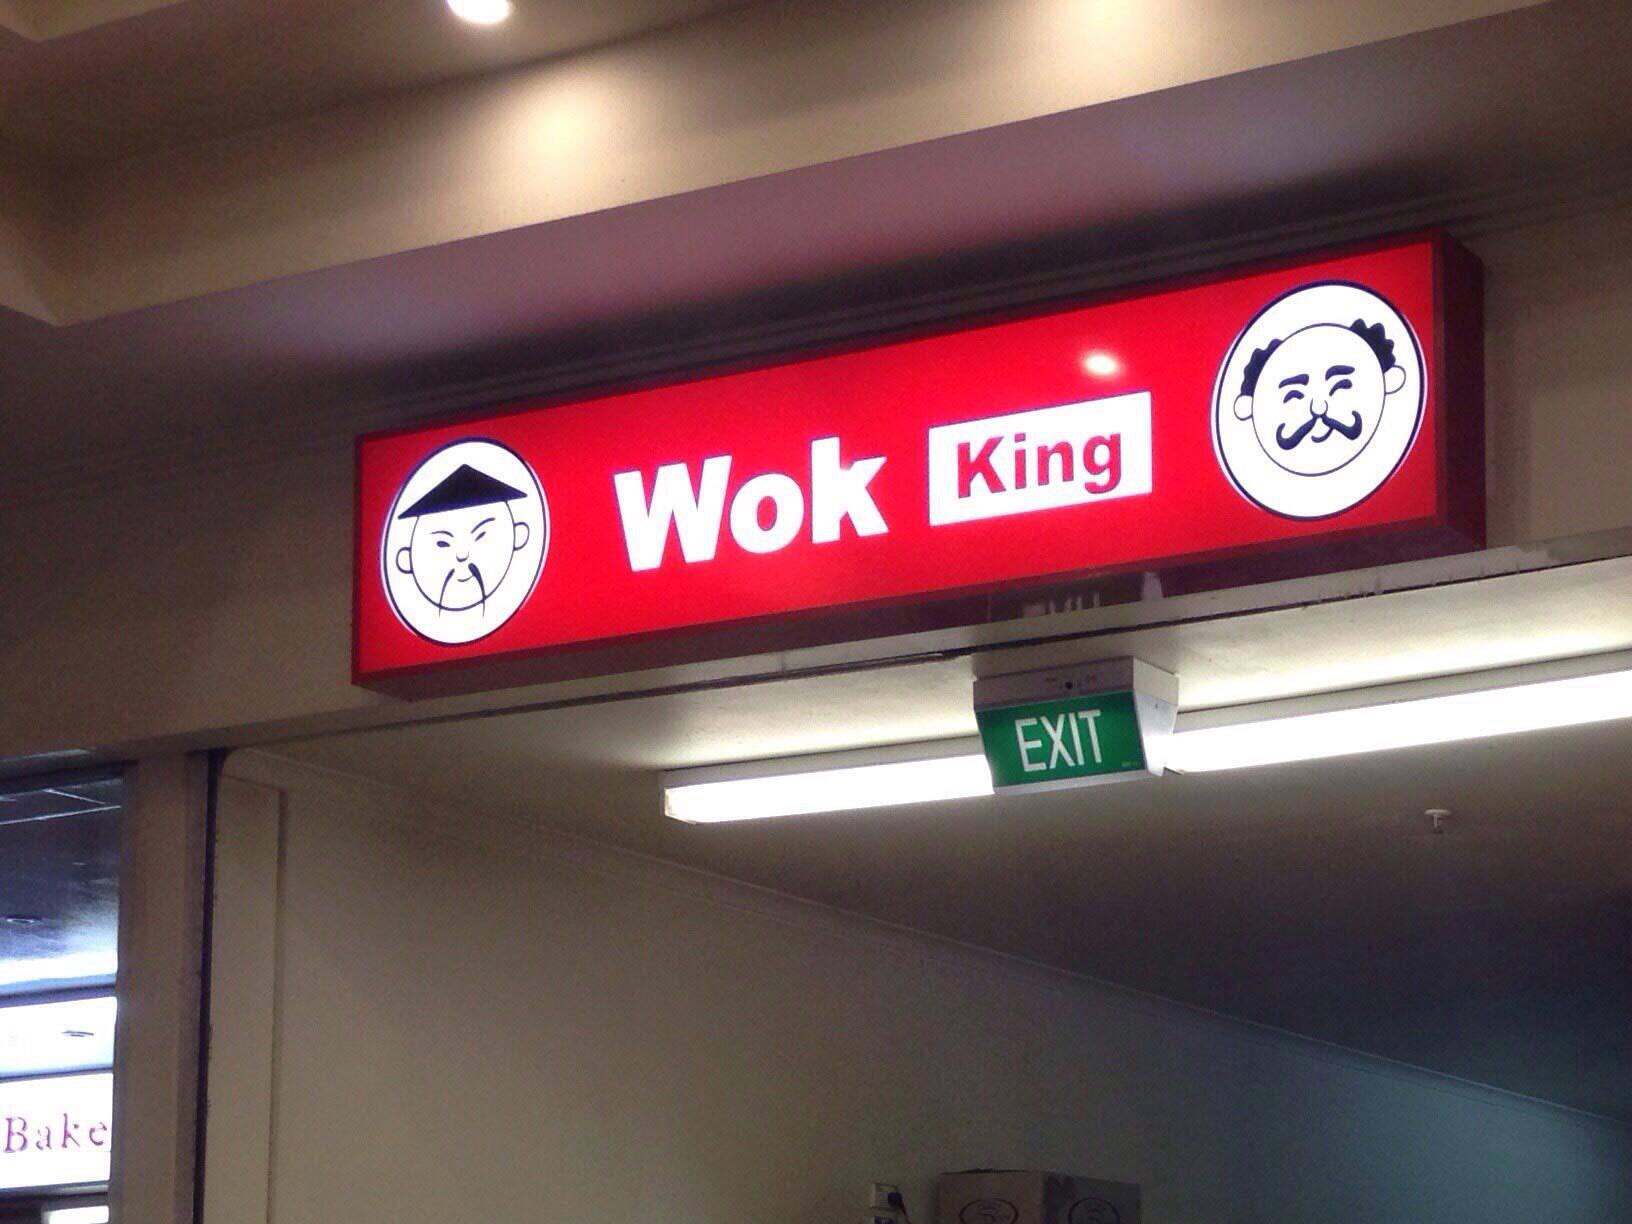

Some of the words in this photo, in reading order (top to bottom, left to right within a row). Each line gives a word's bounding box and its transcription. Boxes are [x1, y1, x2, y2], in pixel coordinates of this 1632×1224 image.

[613, 436, 890, 573] Wok
[955, 427, 1123, 498] King
[1014, 709, 1102, 772] EXIT
